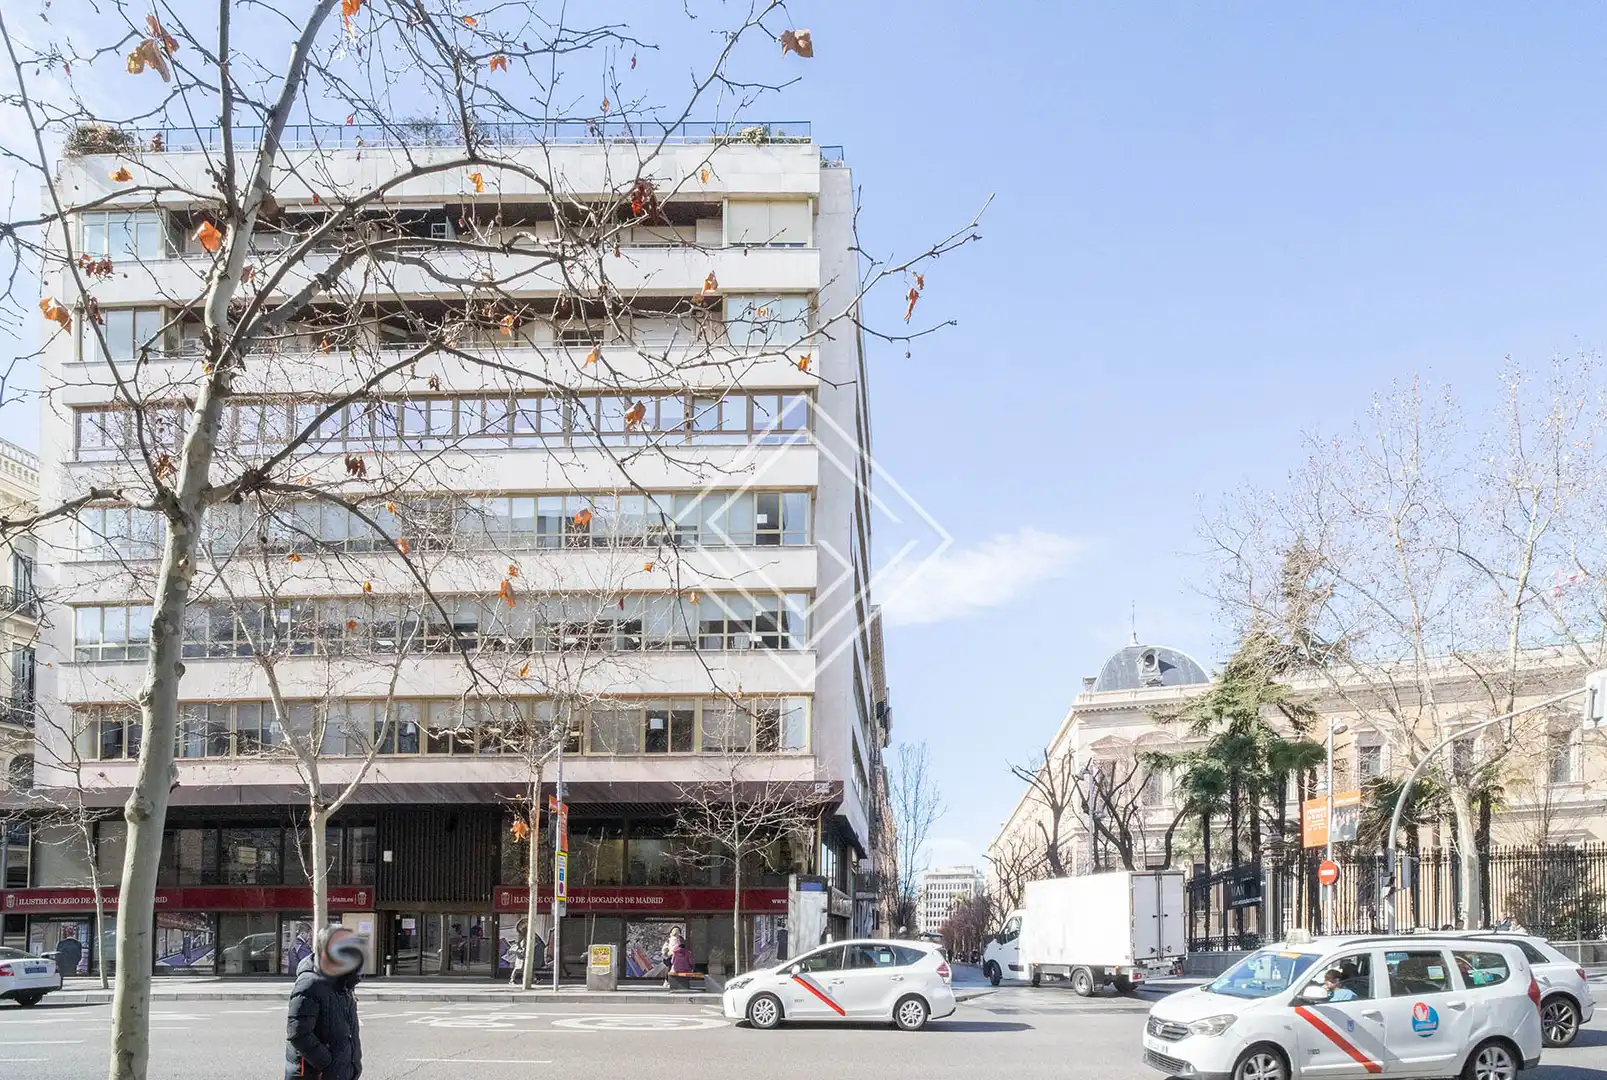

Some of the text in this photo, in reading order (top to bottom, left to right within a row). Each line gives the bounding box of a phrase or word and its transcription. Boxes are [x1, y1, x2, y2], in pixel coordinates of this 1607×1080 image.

[49, 897, 80, 905] COLEGIO
[575, 896, 586, 904] DE
[586, 896, 624, 904] ABOGADOS
[624, 896, 635, 904] DE
[635, 896, 664, 904] MADRID
